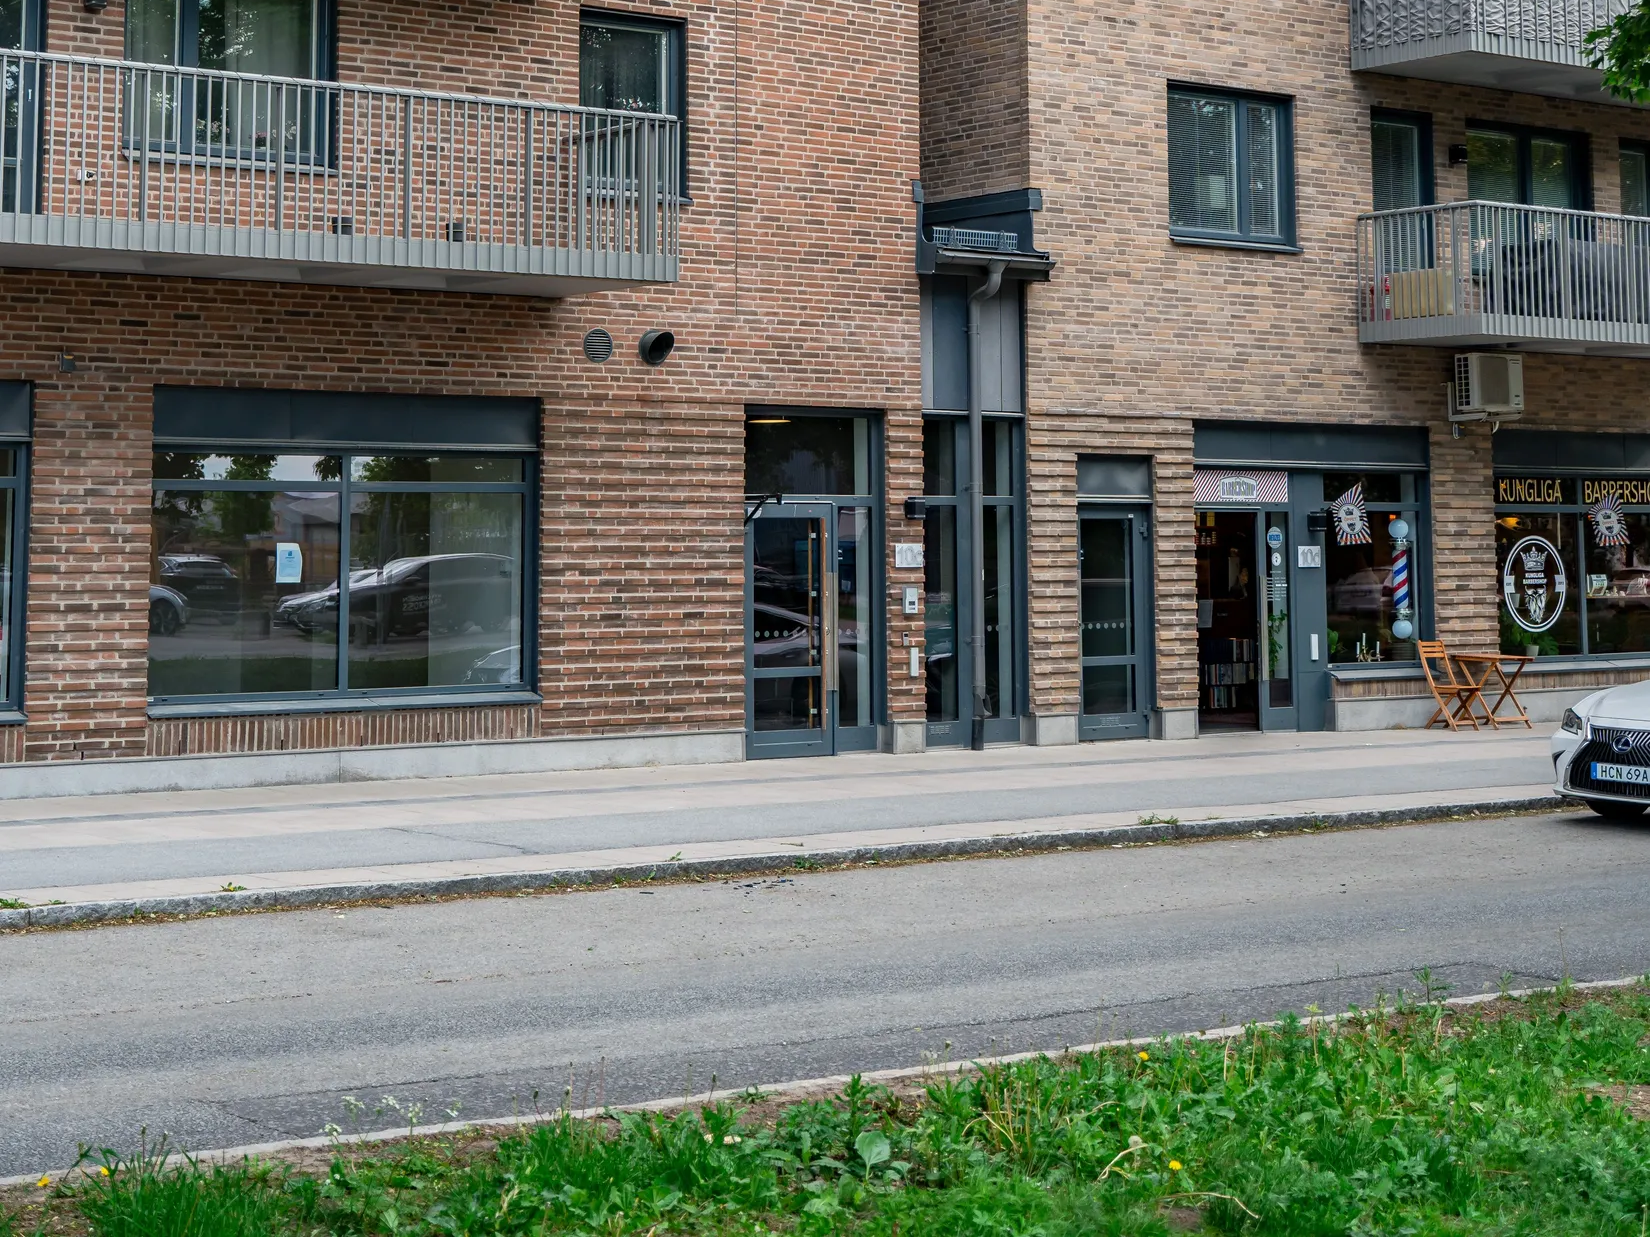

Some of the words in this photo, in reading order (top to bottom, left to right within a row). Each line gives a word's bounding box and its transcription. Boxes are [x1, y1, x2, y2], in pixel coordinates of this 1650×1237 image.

[1499, 479, 1562, 502] KUNGLIGA
[1300, 548, 1320, 566] 10d
[1600, 765, 1623, 780] HCN
[1626, 768, 1649, 782] 69A
